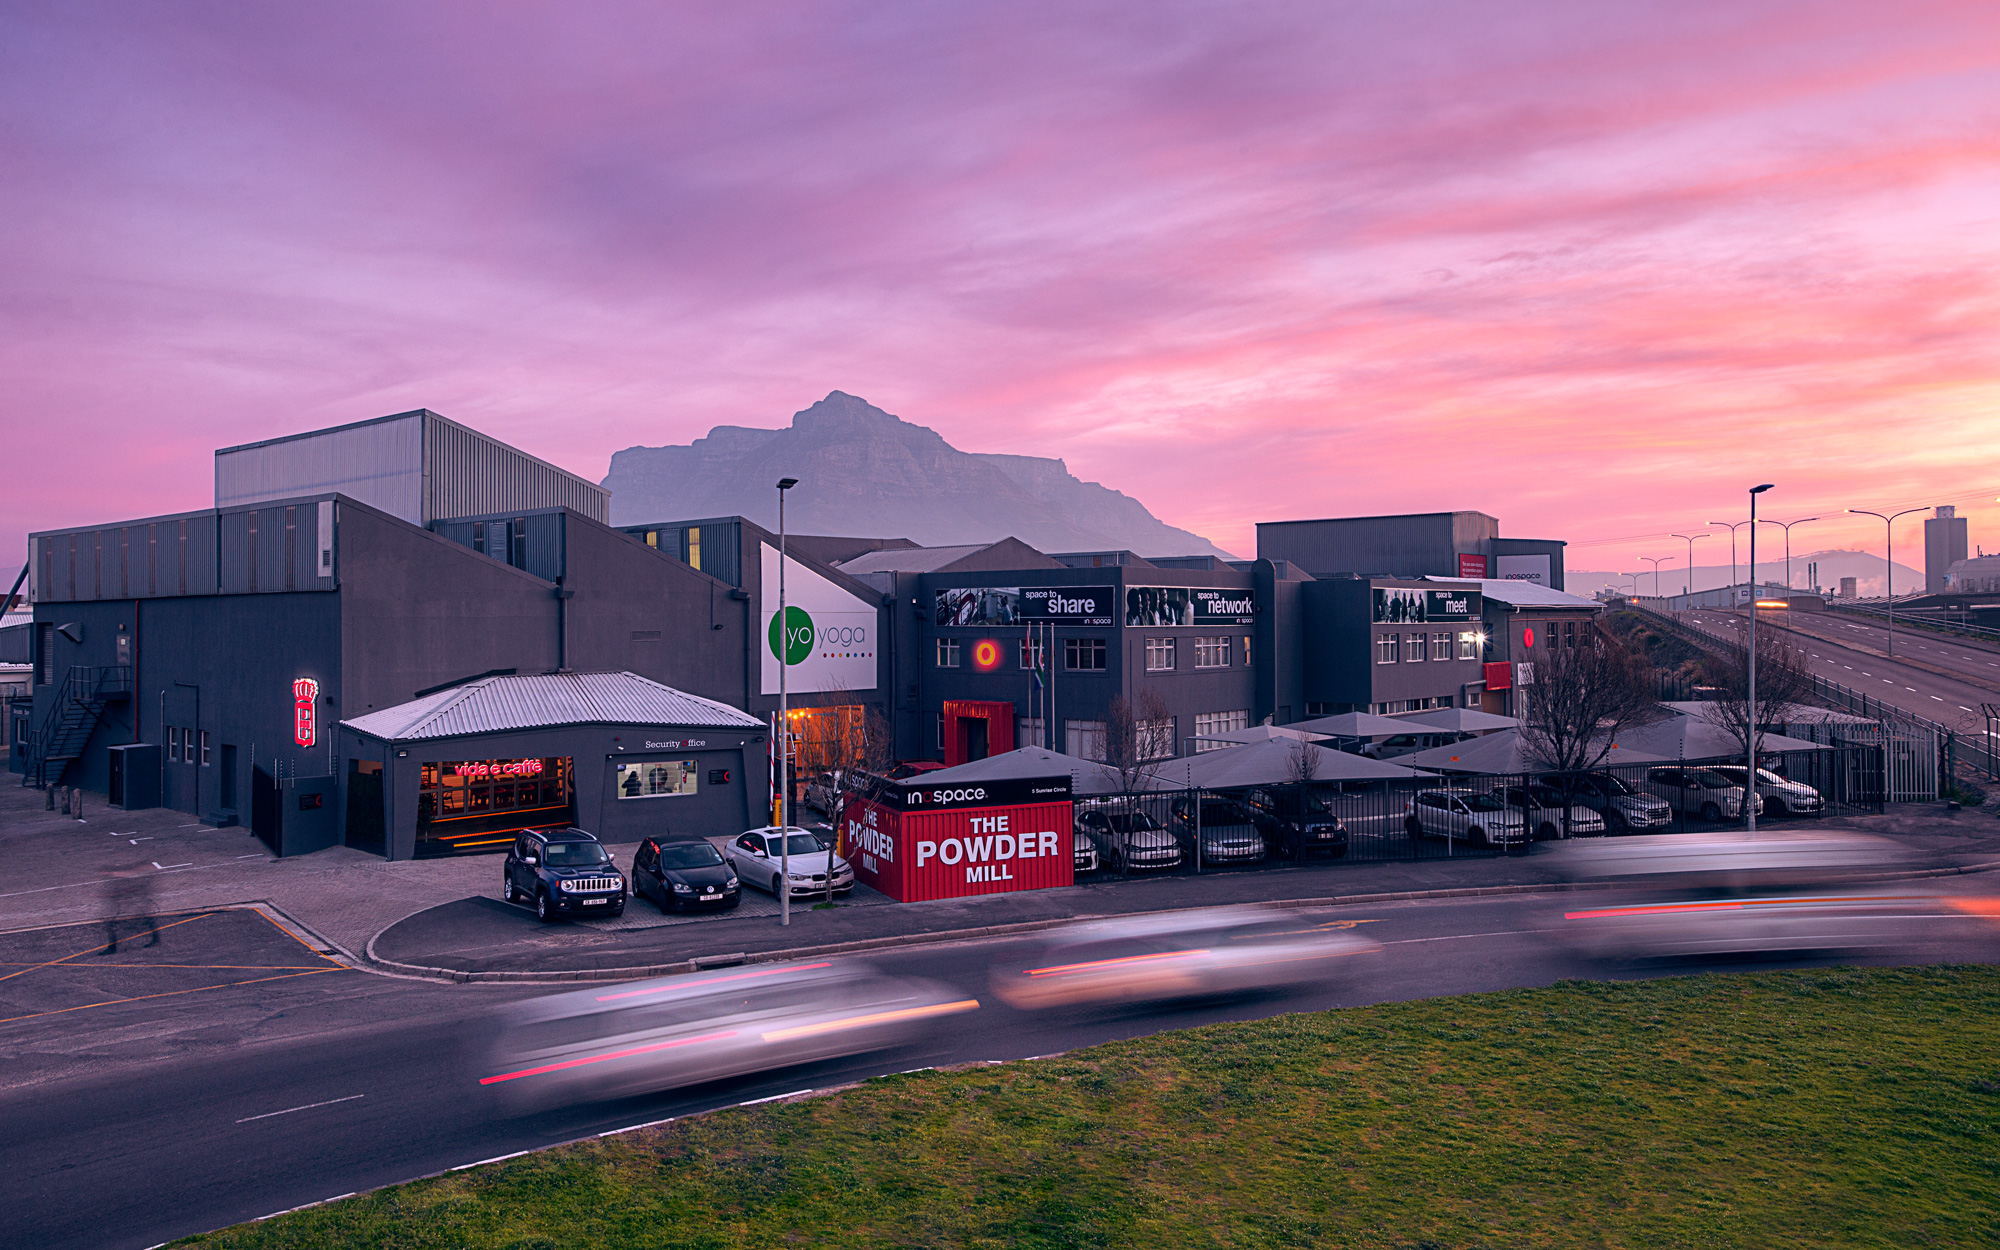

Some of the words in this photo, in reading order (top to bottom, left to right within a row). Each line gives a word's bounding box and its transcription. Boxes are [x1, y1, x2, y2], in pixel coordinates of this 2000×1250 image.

[1026, 591, 1048, 600] space
[1049, 590, 1057, 598] to
[1198, 592, 1213, 600] space
[1436, 592, 1447, 600] space
[1048, 595, 1095, 613] share
[1208, 597, 1252, 613] network
[1446, 597, 1467, 613] meet
[787, 627, 811, 649] yo
[817, 627, 865, 649] yoga
[645, 740, 680, 748] Security
[681, 739, 706, 747] Office
[455, 762, 489, 776] vida
[490, 764, 500, 775] e
[908, 788, 985, 804] inospace
[970, 816, 1009, 834] THE
[849, 819, 893, 863] POWDER
[917, 831, 1058, 868] POWDER
[863, 853, 878, 874] MILL
[966, 864, 1013, 883] MILL
